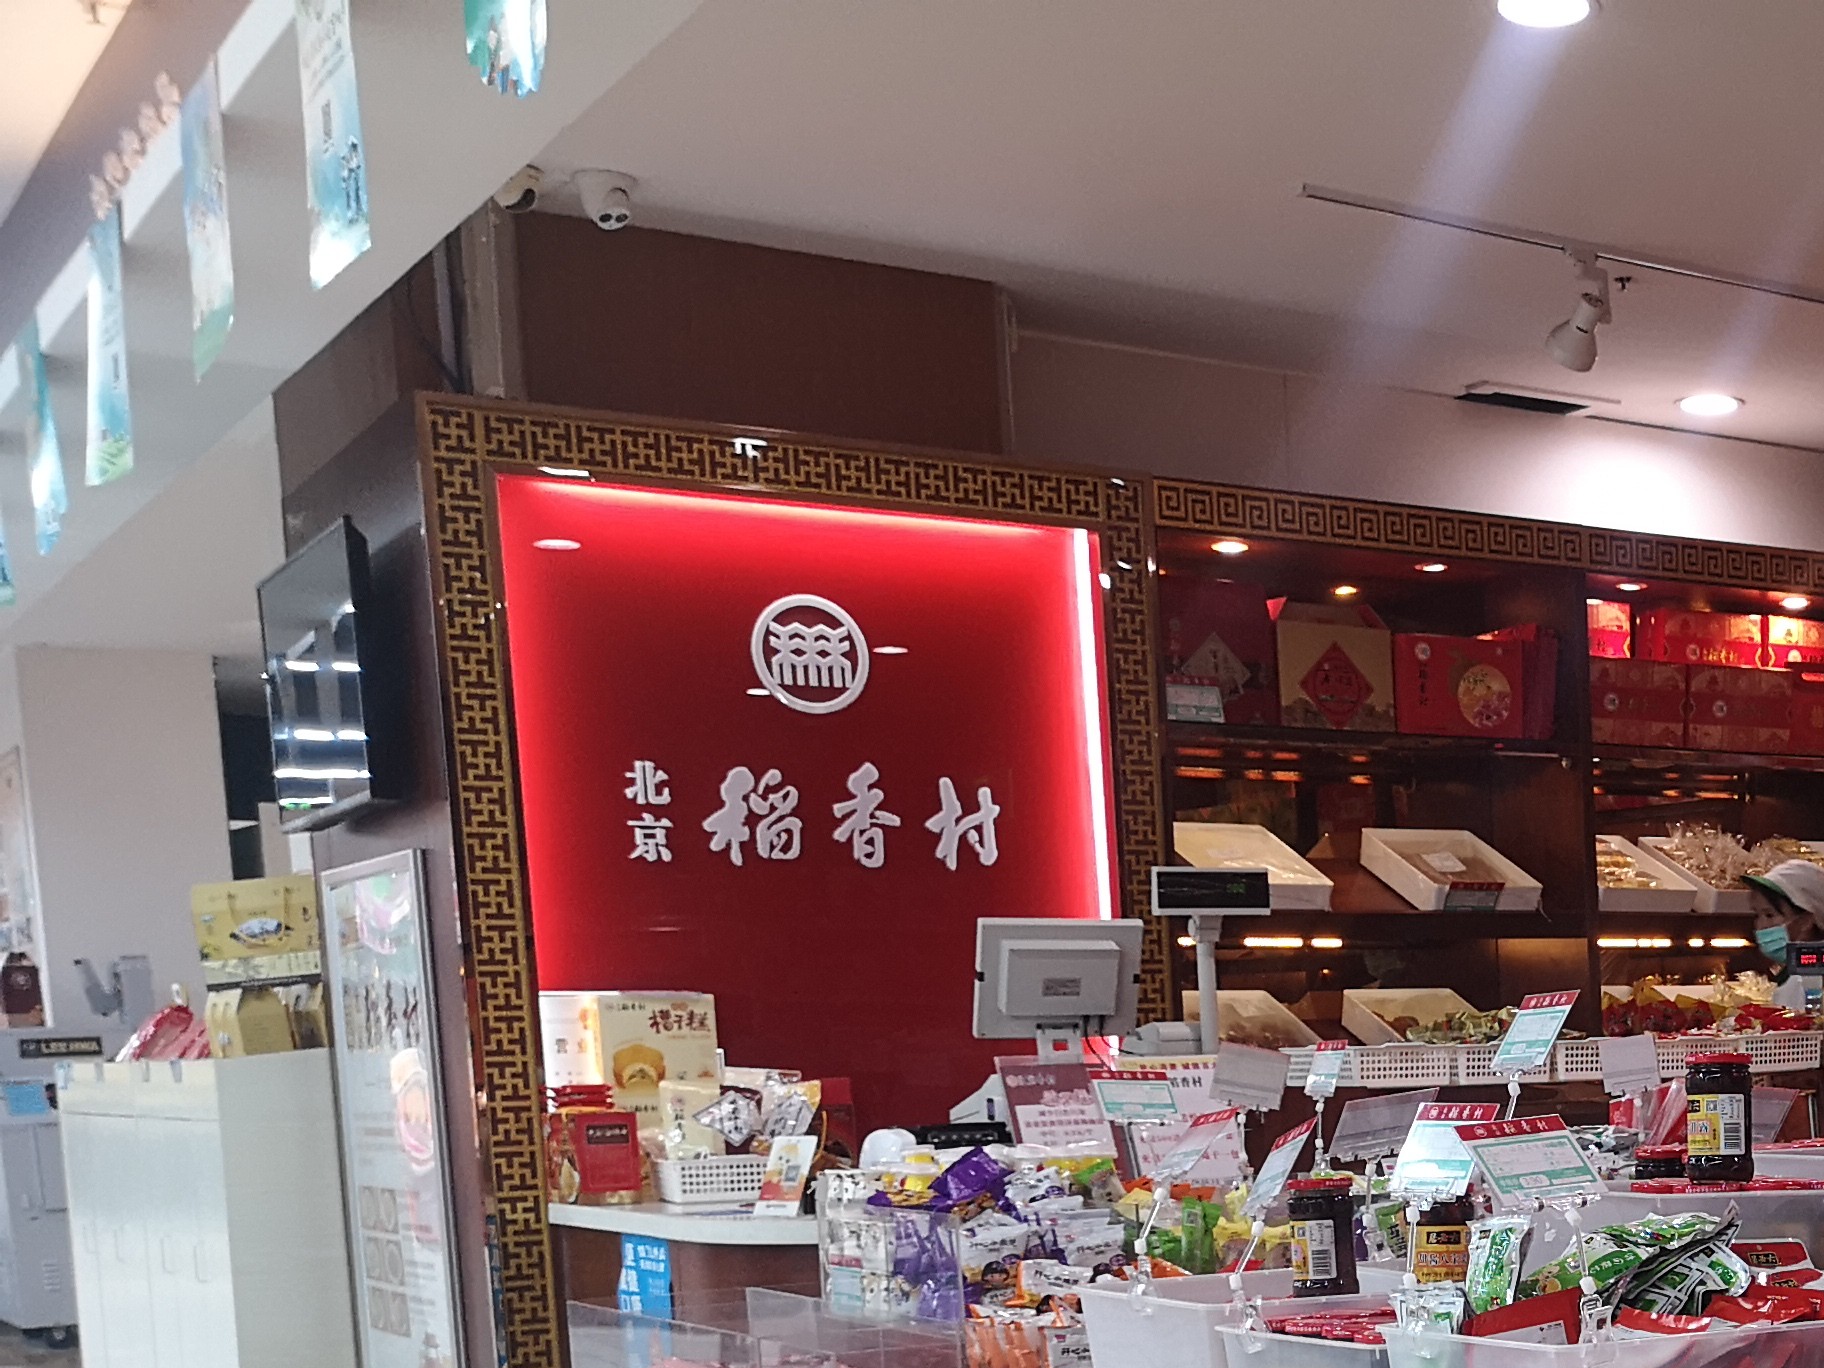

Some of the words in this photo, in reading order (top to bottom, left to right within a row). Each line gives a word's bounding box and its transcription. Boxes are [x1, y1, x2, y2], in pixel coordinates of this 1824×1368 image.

[624, 760, 672, 863] 北京
[702, 761, 1001, 872] 稻香村
